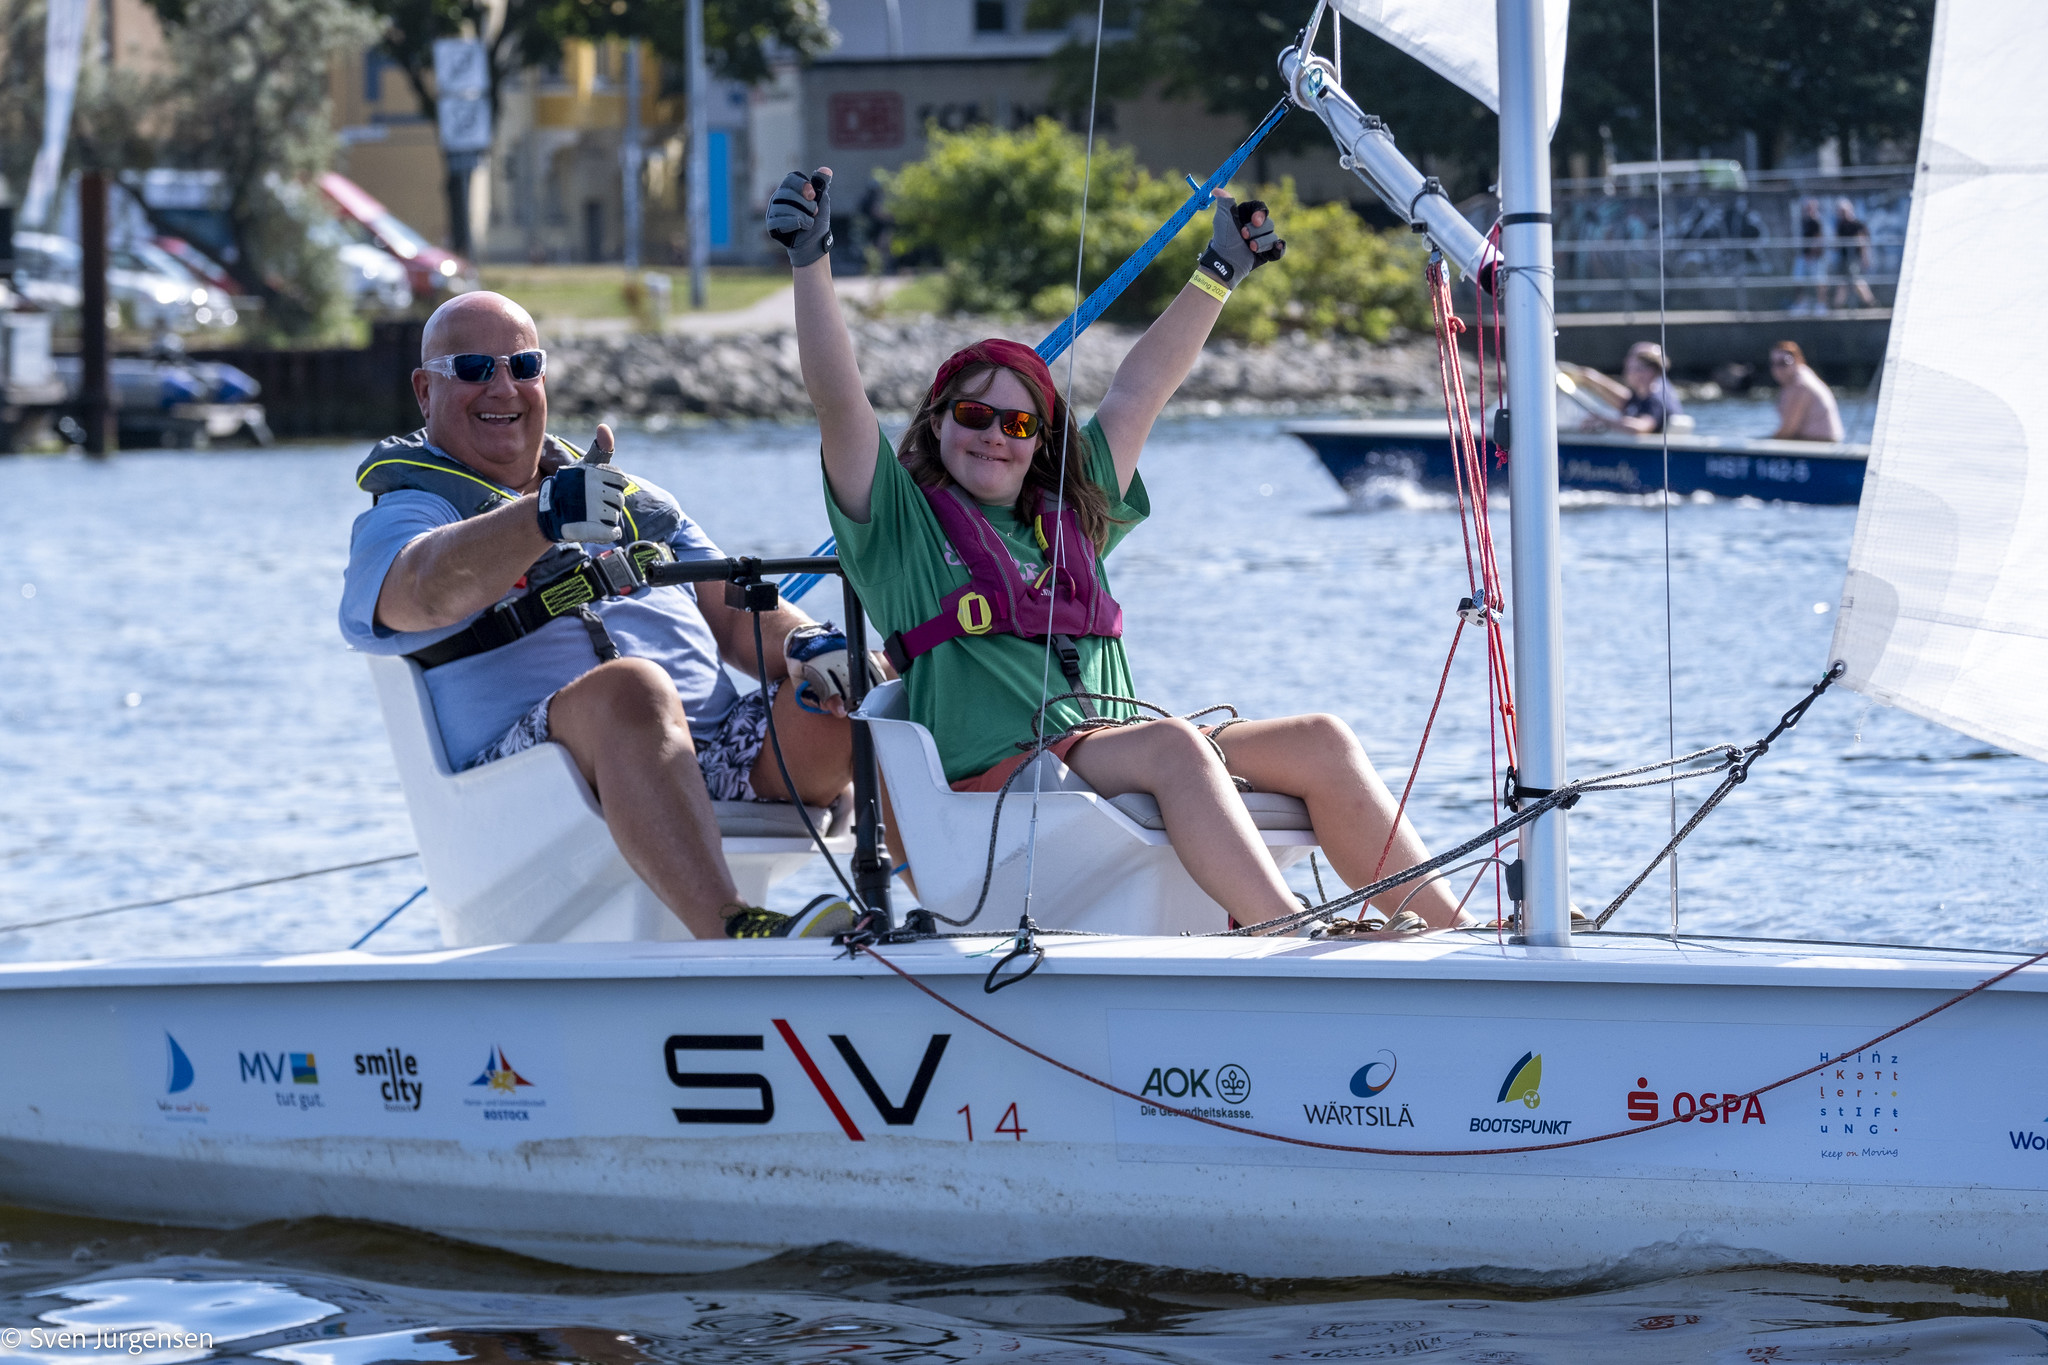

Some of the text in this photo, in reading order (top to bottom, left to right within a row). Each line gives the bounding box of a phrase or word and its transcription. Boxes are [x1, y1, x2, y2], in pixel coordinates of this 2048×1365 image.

[238, 1051, 285, 1084] MV
[1141, 1067, 1213, 1098] AOK
[275, 1092, 298, 1107] tut
[1672, 1091, 1766, 1125] OSPA
[483, 1110, 529, 1121] ROSTOCK
[1141, 1105, 1157, 1116] Die
[1303, 1101, 1415, 1128] WÄRTSILÄ
[957, 1102, 1028, 1141] 14
[1469, 1117, 1572, 1135] BOOTSPUNKT
[2009, 1131, 2048, 1150] Wo
[1821, 1150, 1843, 1160] Keep
[1861, 1146, 1899, 1158] Moving
